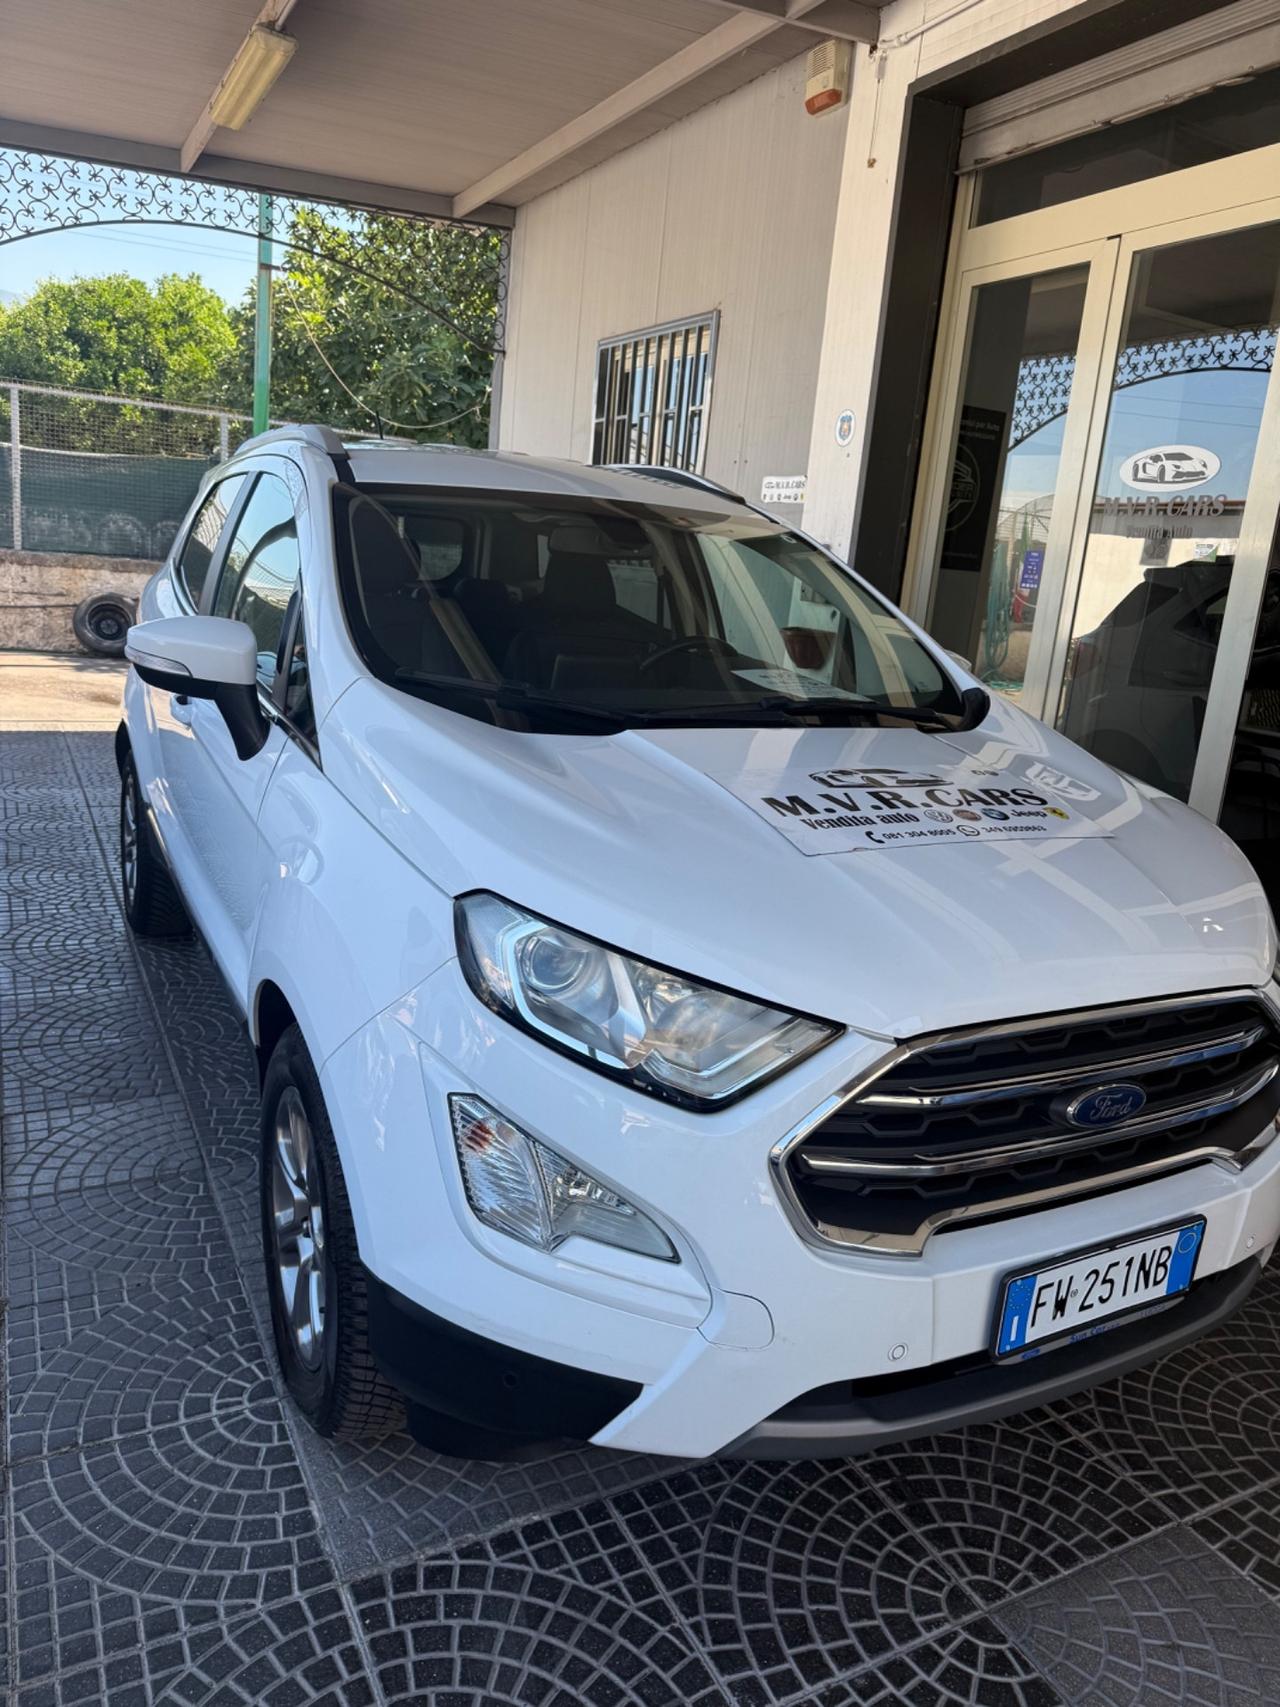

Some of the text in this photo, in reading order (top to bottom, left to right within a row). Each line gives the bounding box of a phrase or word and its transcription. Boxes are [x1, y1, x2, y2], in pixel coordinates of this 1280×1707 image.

[800, 815, 873, 831] Vendita
[1010, 808, 1048, 818] Jeep
[1089, 1093, 1133, 1120] Ford
[1031, 1246, 1172, 1328] FW 251NB
